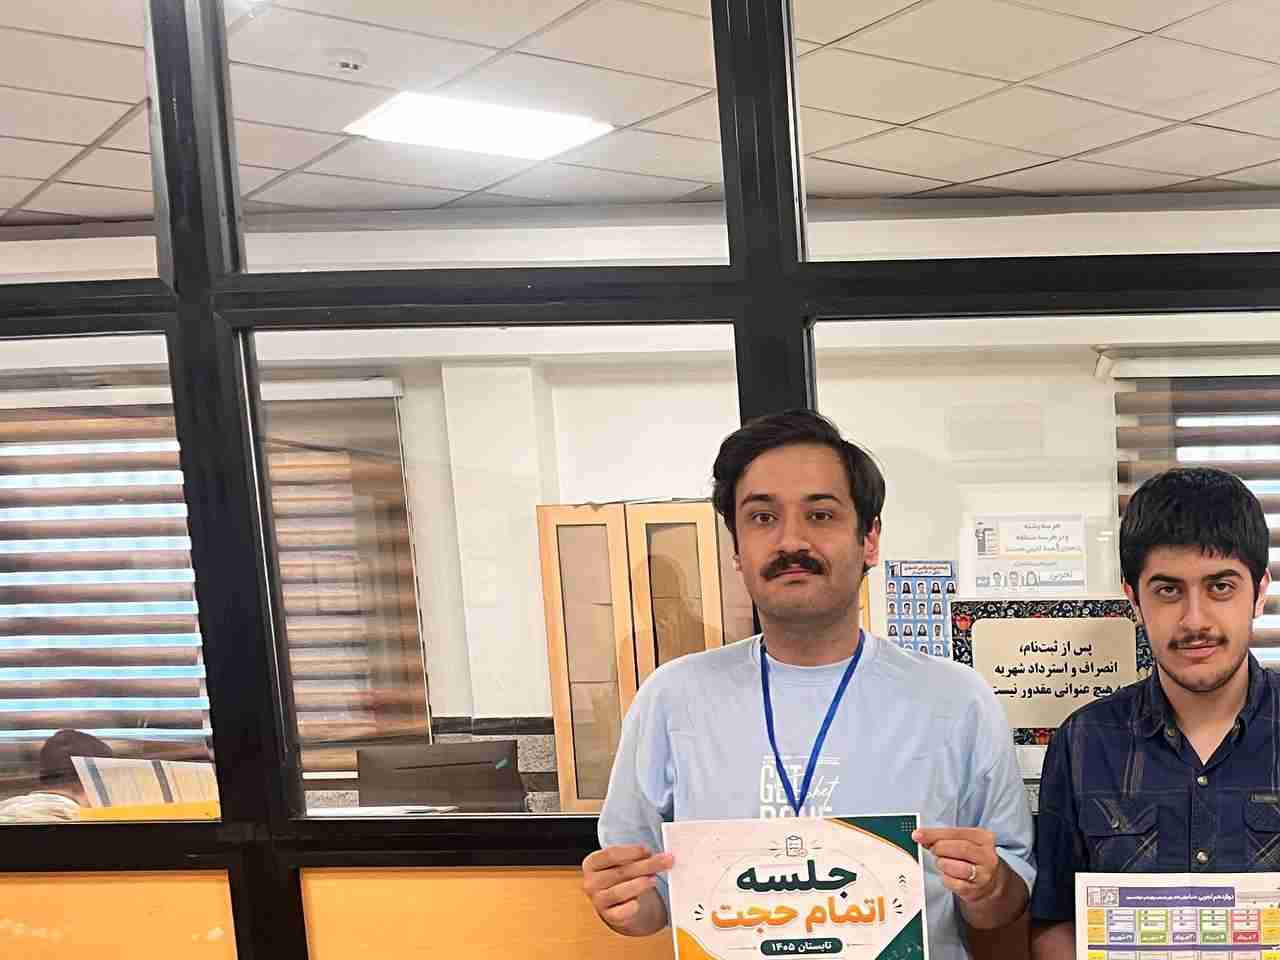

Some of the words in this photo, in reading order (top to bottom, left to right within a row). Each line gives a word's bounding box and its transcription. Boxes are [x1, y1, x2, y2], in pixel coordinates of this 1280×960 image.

[1060, 641, 1071, 656] از
[1073, 643, 1092, 656] پس
[994, 663, 1026, 677] شهریه
[1028, 662, 1068, 677] استرداد
[1070, 666, 1078, 677] و
[1079, 662, 1118, 677] انصراف
[1021, 683, 1052, 698] مقدور
[1054, 683, 1090, 697] عنوانی
[736, 859, 858, 900] جلسه
[711, 903, 799, 935] حجت
[804, 895, 888, 933] اتمام
[771, 942, 796, 952] ۱۴۰۵
[798, 941, 832, 953] تابستان
